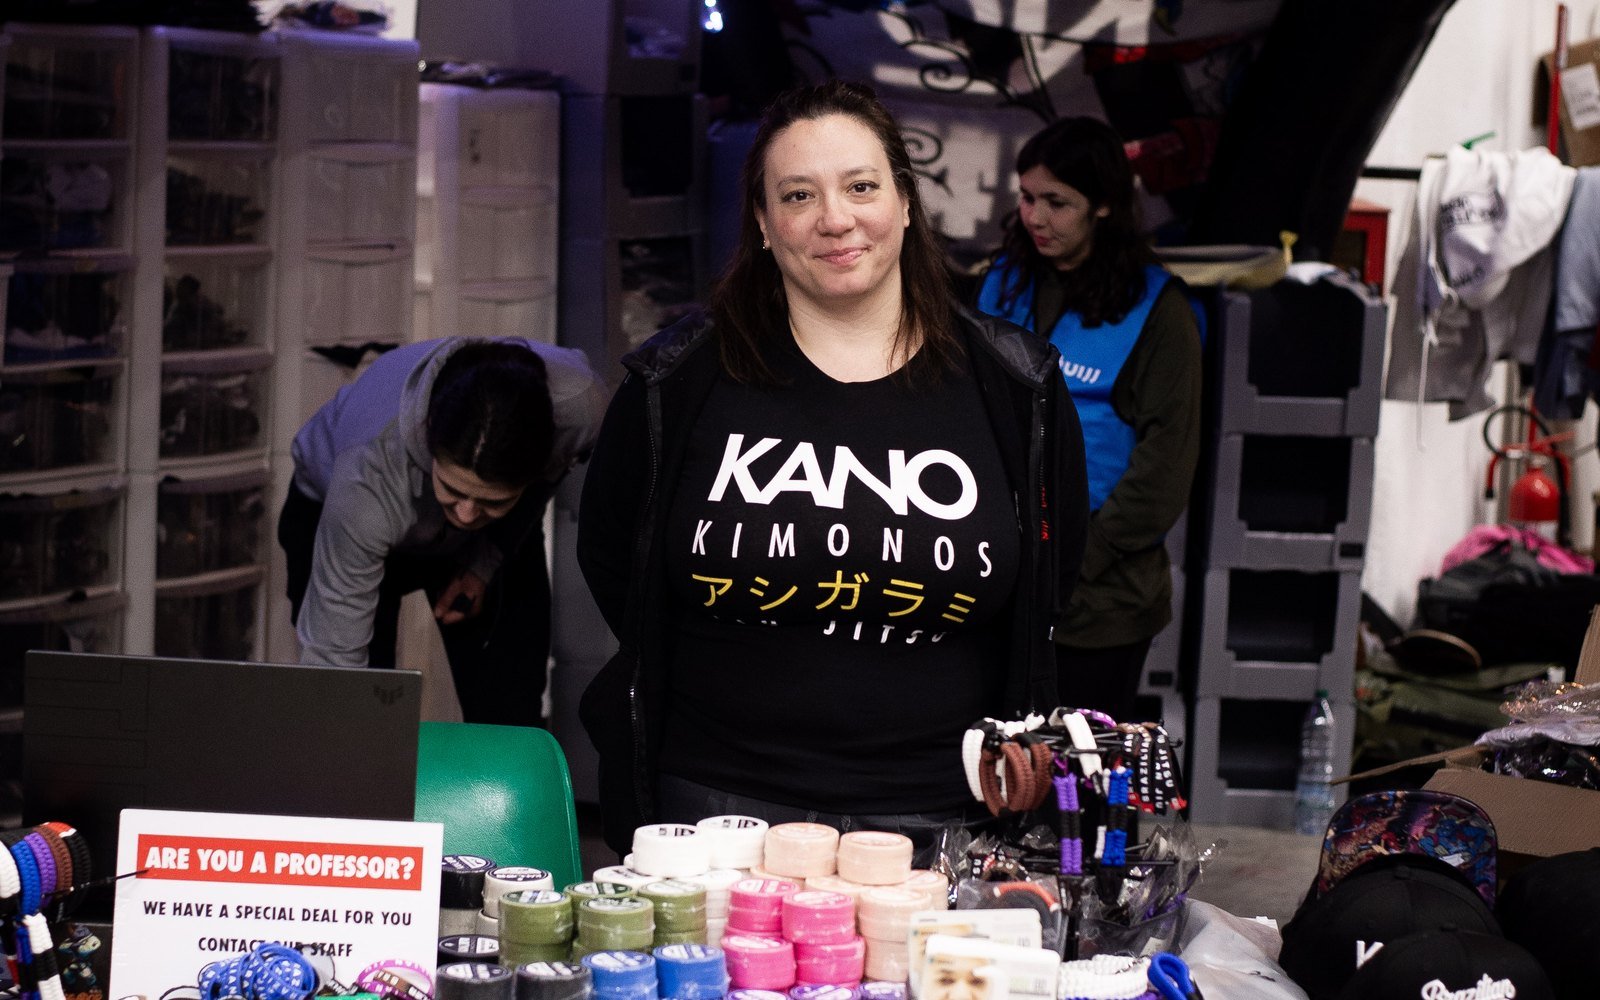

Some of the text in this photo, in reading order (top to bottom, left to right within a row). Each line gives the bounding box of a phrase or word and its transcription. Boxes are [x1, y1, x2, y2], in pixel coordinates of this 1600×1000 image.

[707, 433, 978, 520] KANO
[692, 519, 992, 577] KIMONOS
[692, 570, 976, 623] アシガラミ
[145, 846, 190, 870] ARE
[197, 848, 243, 873] YOU
[250, 851, 267, 874] A
[274, 852, 415, 880] PROFESSOR?
[143, 901, 412, 927] WE HAVE A SPECIAL DEAL FOR YOU
[198, 937, 265, 953] CONTAC
